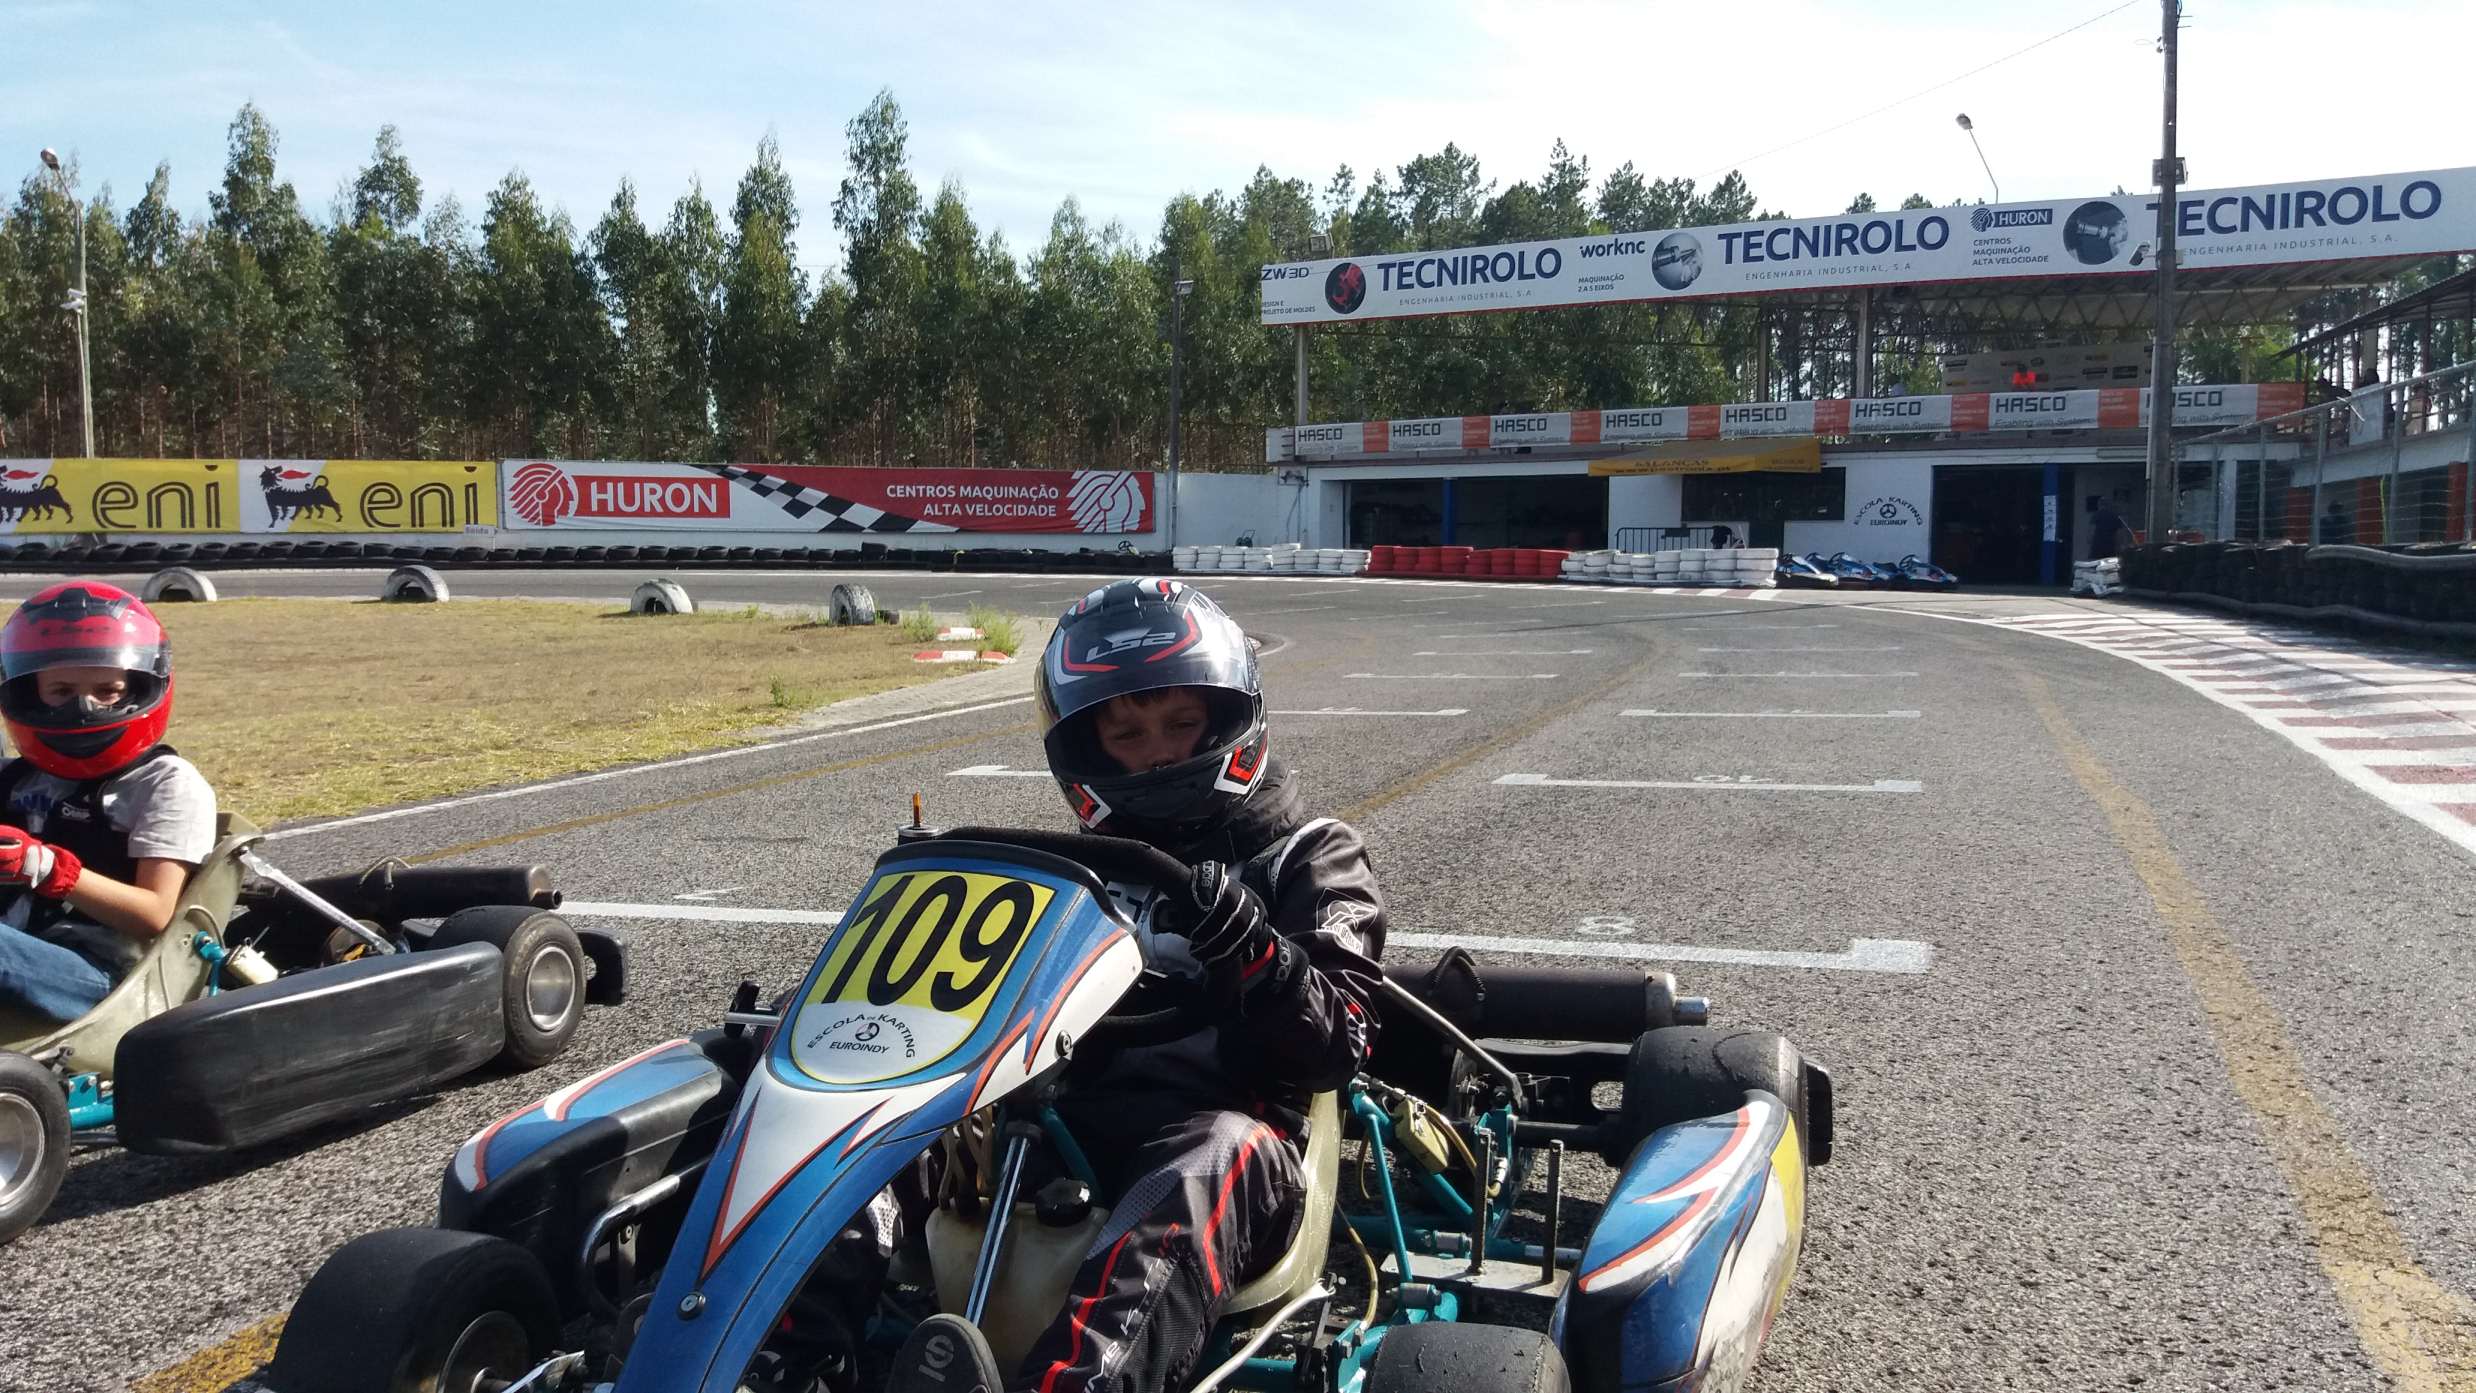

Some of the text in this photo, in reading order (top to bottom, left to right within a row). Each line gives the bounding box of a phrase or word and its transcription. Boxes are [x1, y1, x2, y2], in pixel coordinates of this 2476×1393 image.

[1999, 210, 2048, 225] HURON
[1579, 238, 1646, 258] worknc
[1718, 215, 1949, 265] TECNIROLO
[1973, 238, 2012, 246] CENTROS
[1973, 245, 2031, 256] MAQUINAÇÃO
[1996, 255, 2049, 264] VELOCIDADE
[1377, 247, 1562, 291] TECNIROLO
[1746, 268, 1813, 281] ENGENHARIA
[1578, 273, 1624, 283] MAQUINAÇÃO
[1400, 296, 1454, 305] ENGENHARIA
[1996, 396, 2066, 413] HASCO
[2146, 391, 2222, 408] SCO
[1726, 407, 1787, 423] HASCO
[1856, 401, 1922, 417] HASCO
[1495, 418, 1547, 433] HASCO
[1606, 413, 1662, 428] HASCO
[1298, 428, 1342, 442] HASCO
[1393, 423, 1440, 437] HASCO
[92, 465, 220, 528] eni
[360, 466, 478, 527] eni
[590, 482, 717, 513] HURON
[886, 484, 1059, 501] CENTROS MAQUINAÇÃO
[923, 503, 1057, 517] ALTA VELOCIDADE
[1086, 628, 1177, 662] LS2
[821, 875, 1035, 1012] 109
[807, 1013, 865, 1049] ESCOLA
[878, 1013, 916, 1058] KARTING
[829, 1041, 890, 1054] EUROINDY
